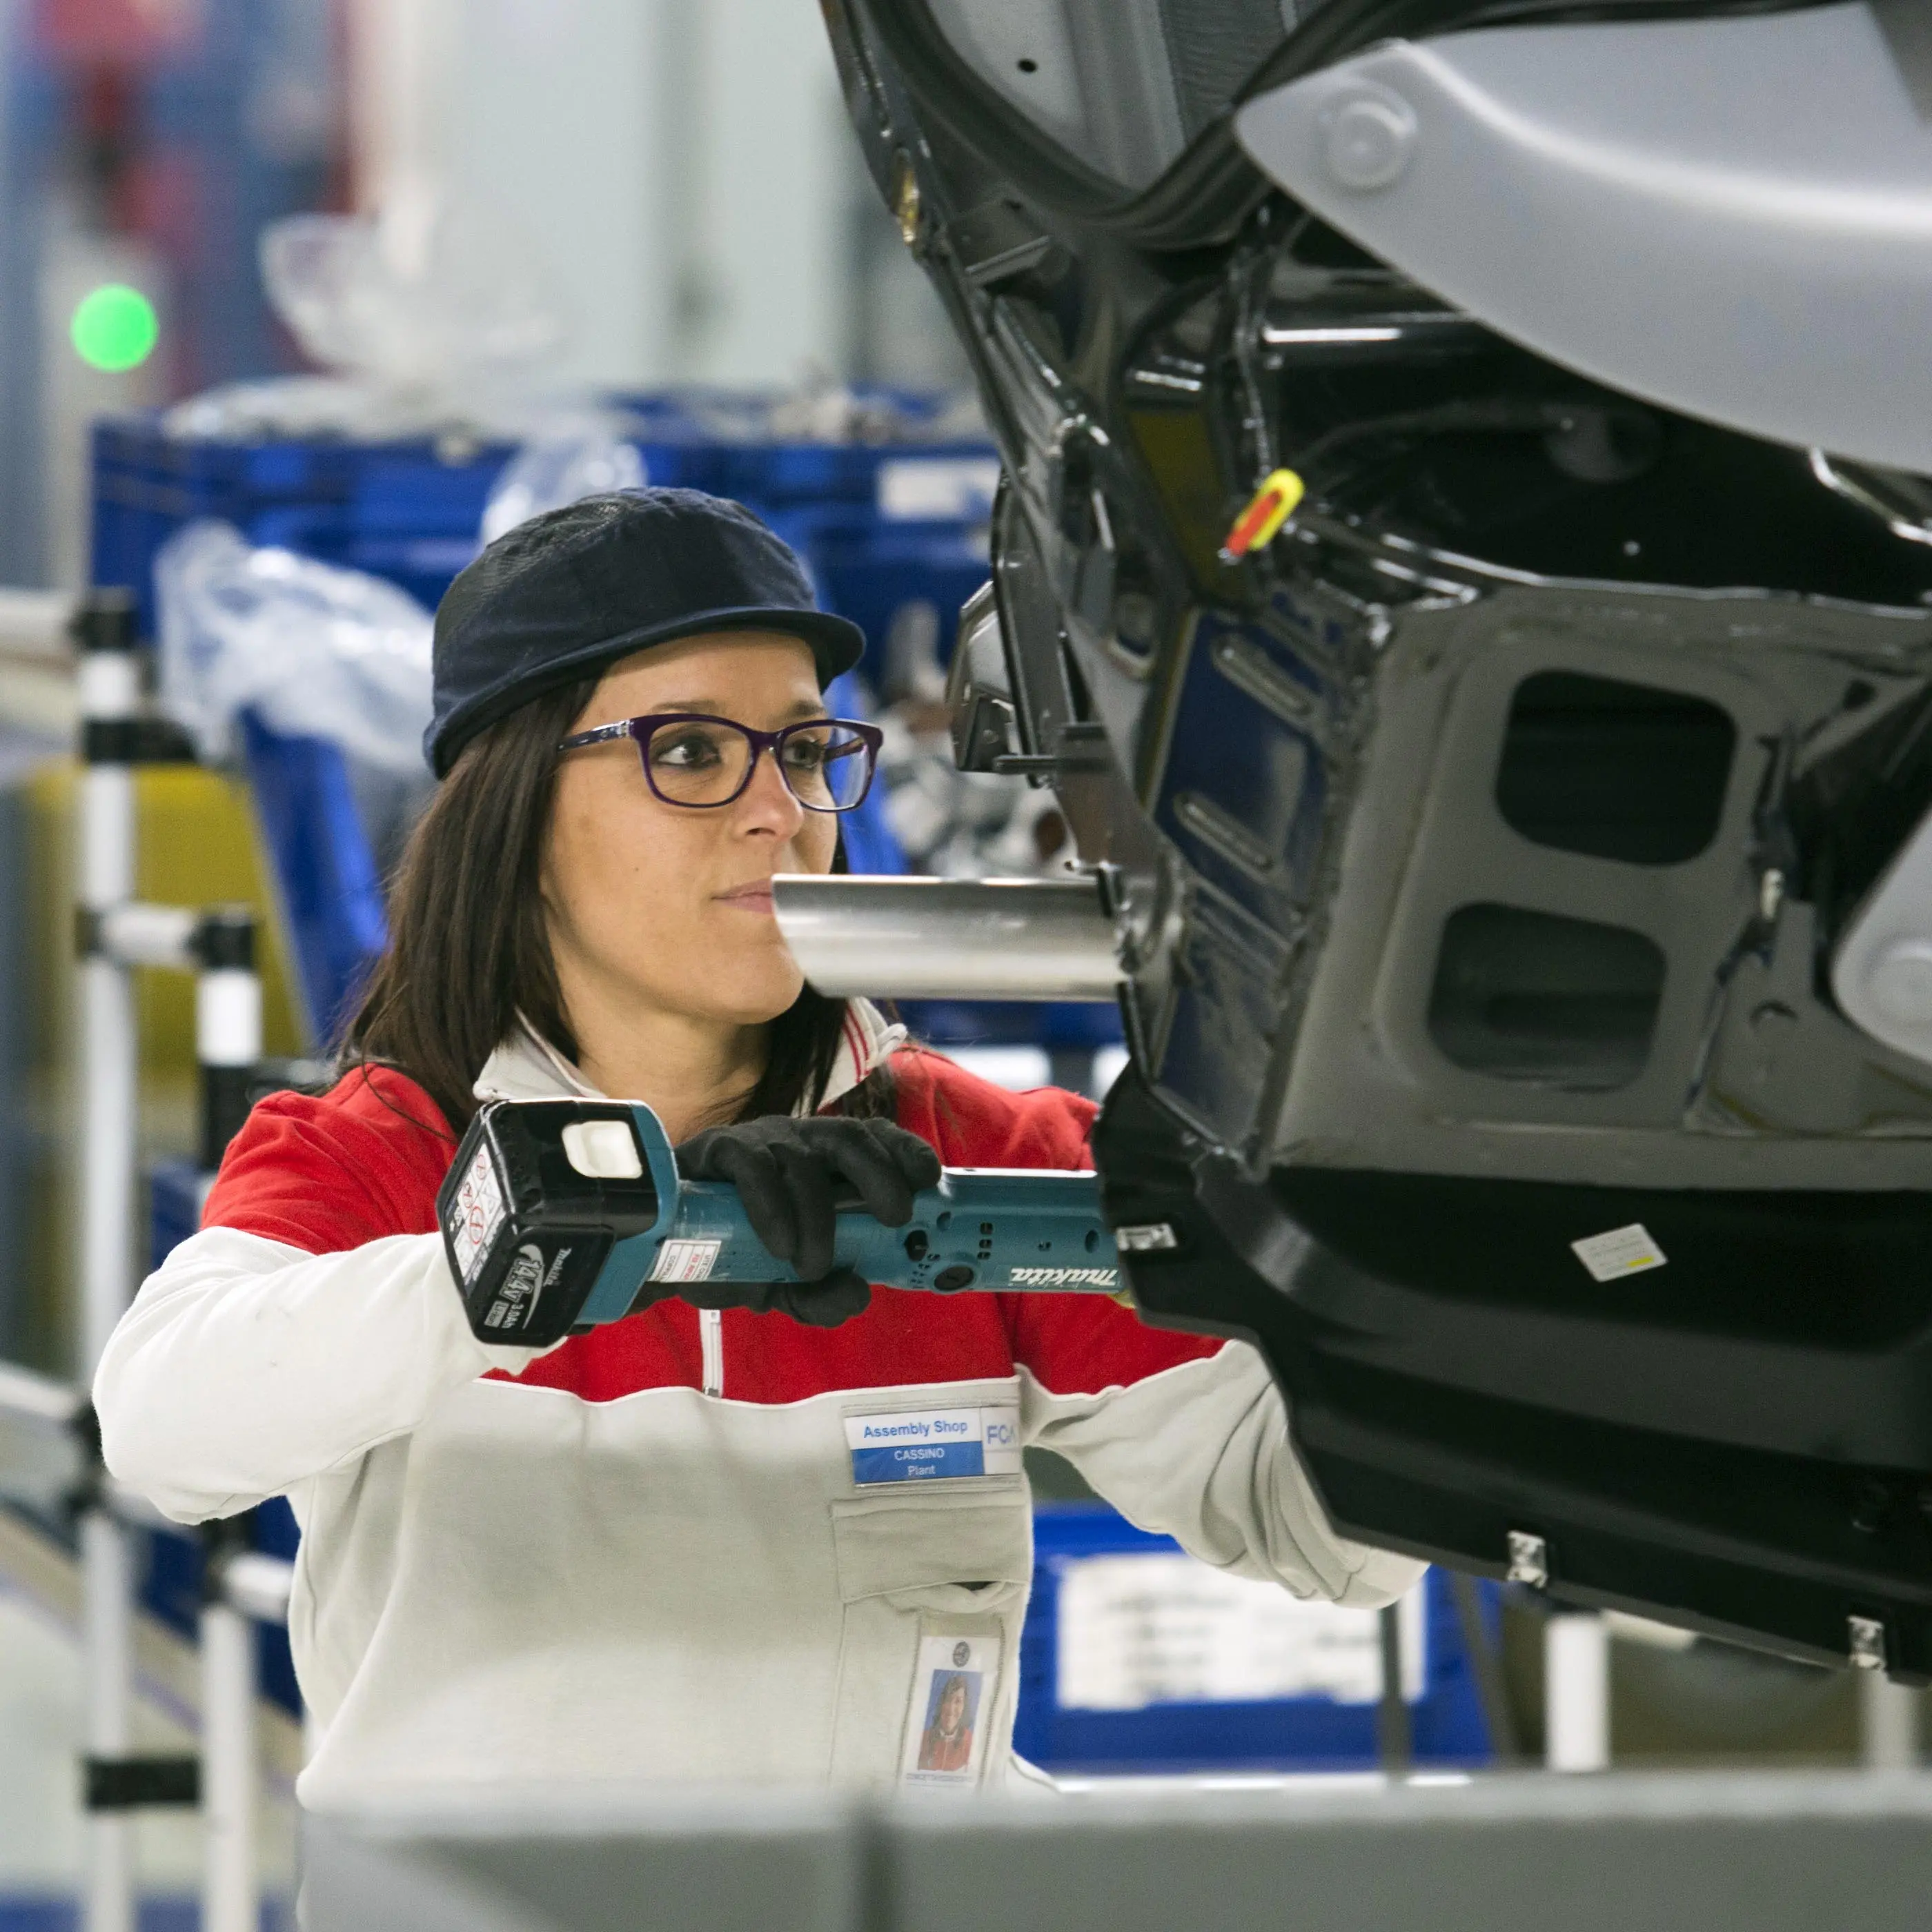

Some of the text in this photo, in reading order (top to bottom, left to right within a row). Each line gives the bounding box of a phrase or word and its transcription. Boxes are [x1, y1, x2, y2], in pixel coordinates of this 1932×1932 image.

[864, 1419, 967, 1438] Assembly Shop
[894, 1448, 945, 1461] CASSINO
[907, 1465, 936, 1476] Plant
